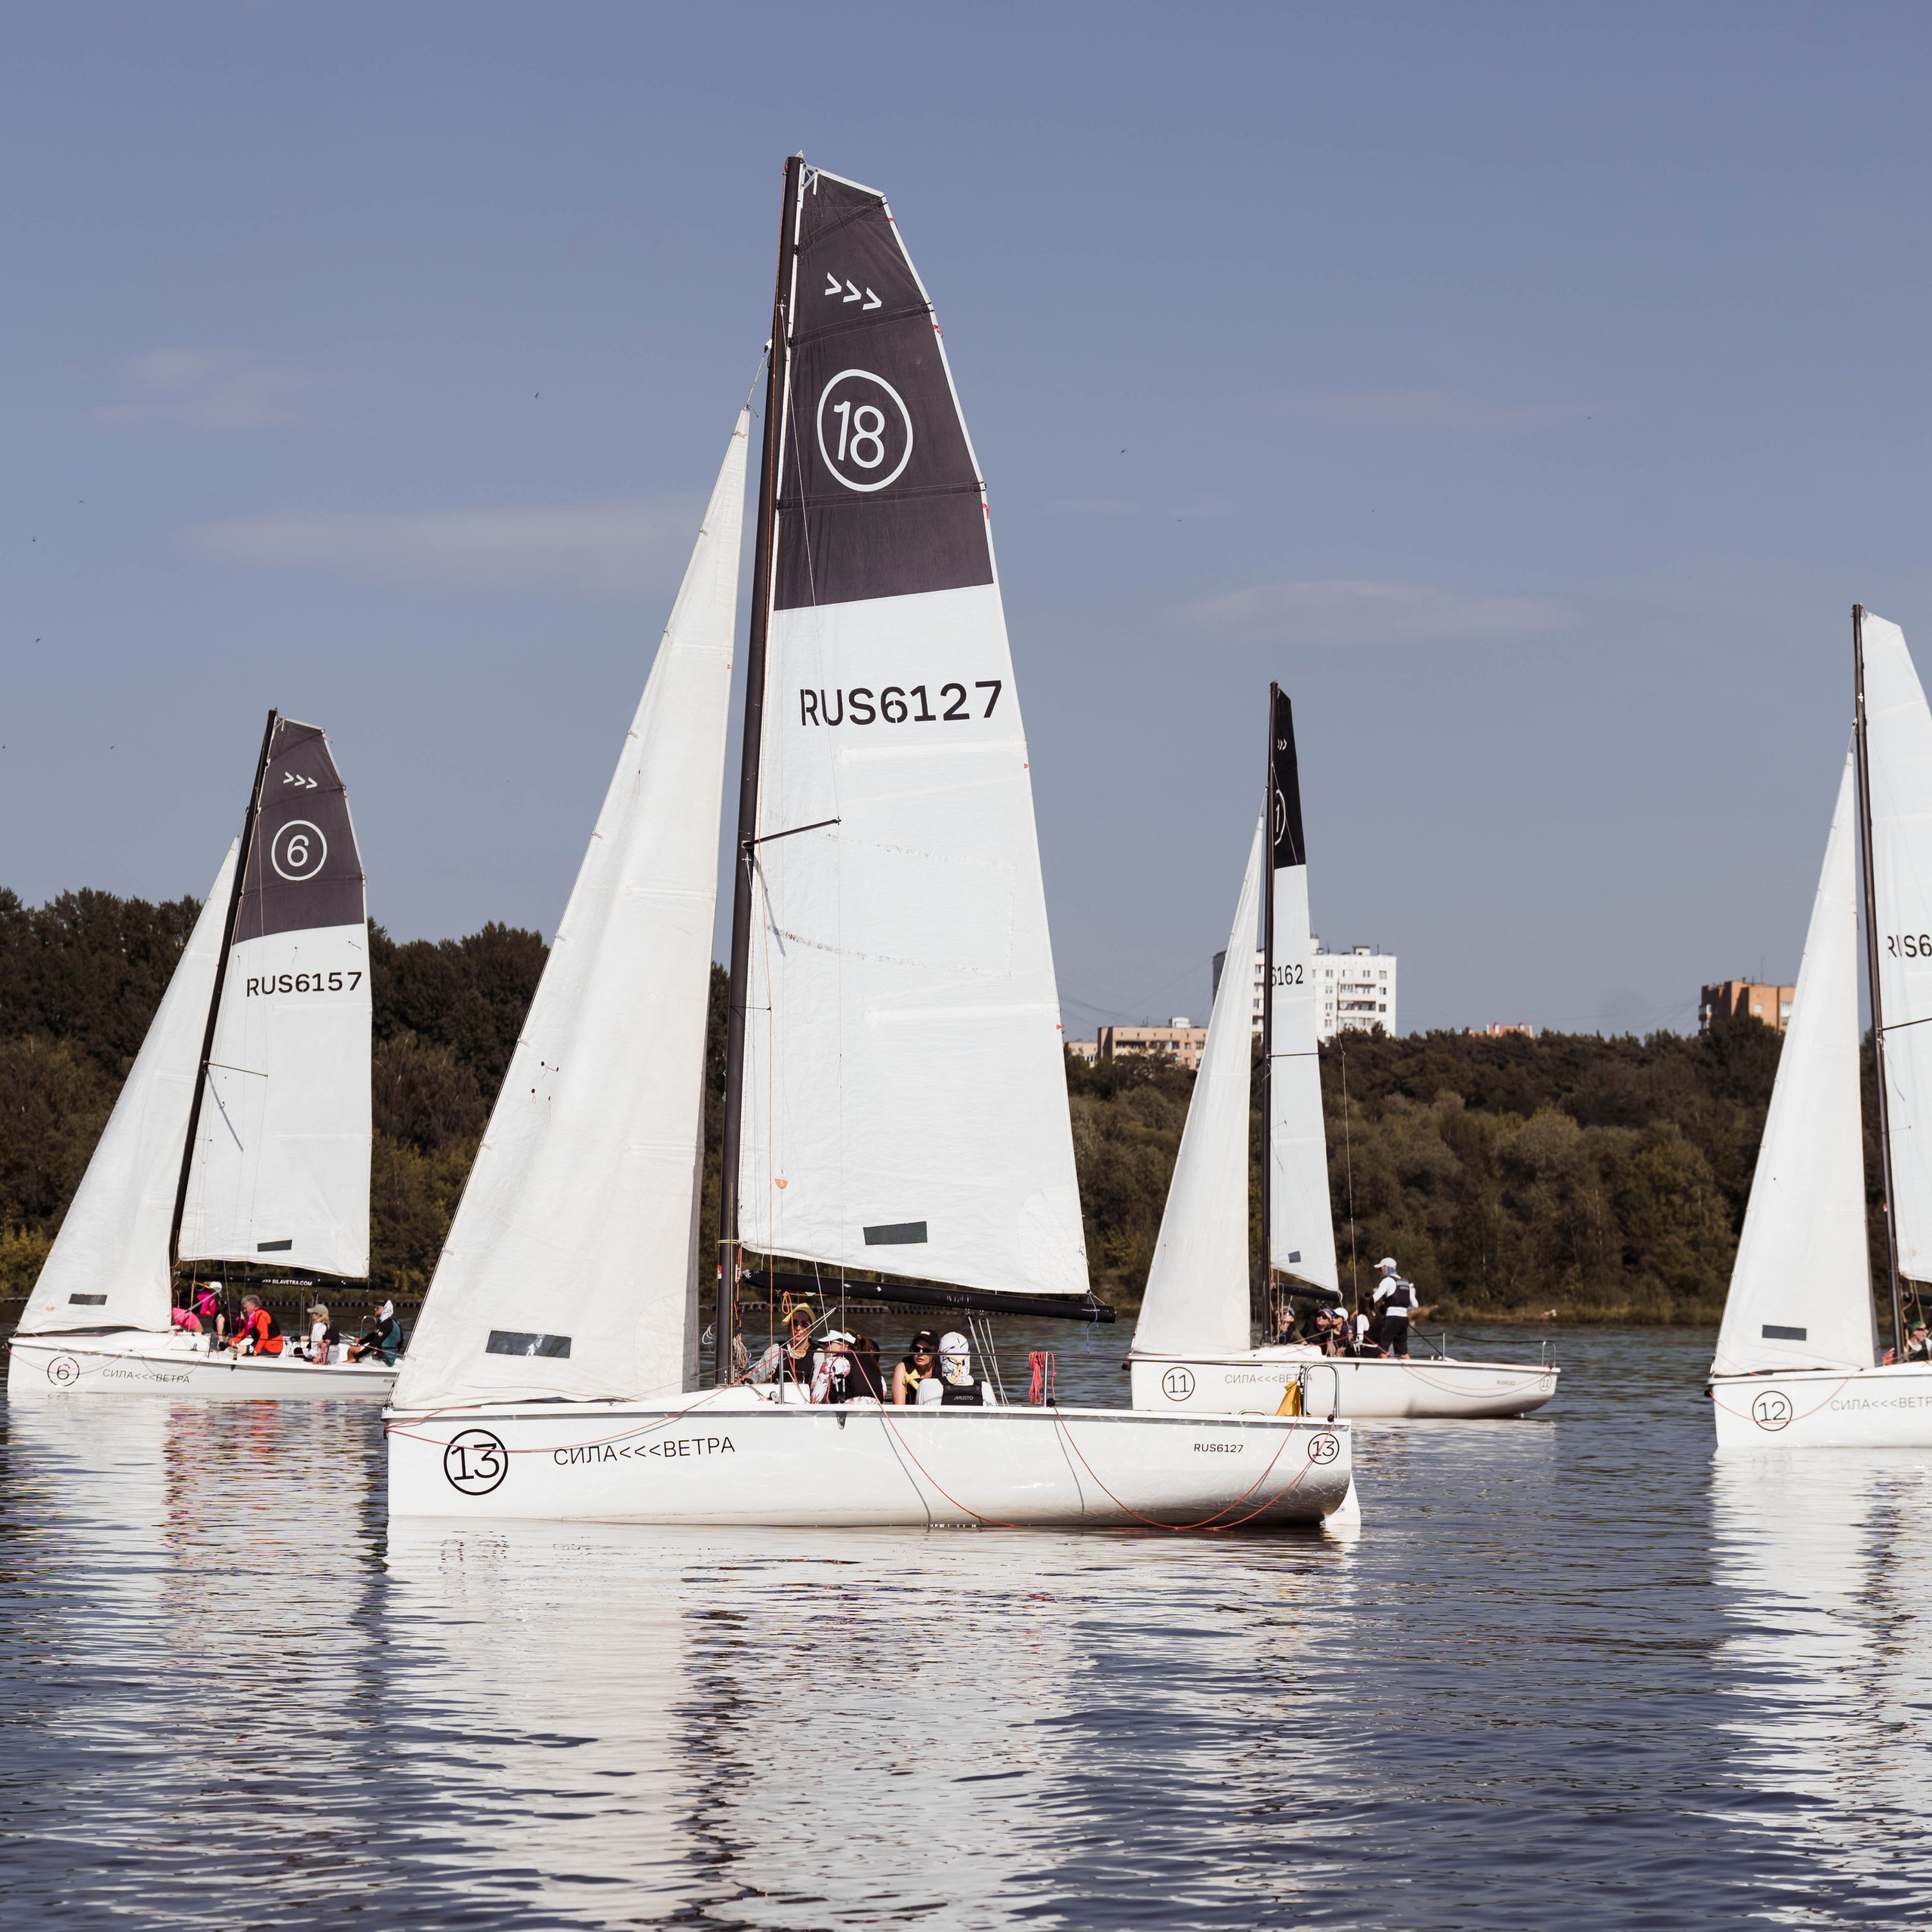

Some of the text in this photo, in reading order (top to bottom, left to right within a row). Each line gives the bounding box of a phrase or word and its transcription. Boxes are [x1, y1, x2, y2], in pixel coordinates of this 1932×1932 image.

[834, 401, 886, 469] 18
[801, 680, 1002, 727] RUS6127
[287, 835, 309, 867] 6
[246, 971, 362, 997] RUS6157
[57, 1364, 70, 1380] 6
[1168, 1374, 1190, 1393] 11
[1542, 1379, 1550, 1388] 11
[1758, 1401, 1787, 1422] 12
[1193, 1443, 1244, 1454] RUS6127
[1312, 1440, 1335, 1457] 13
[451, 1442, 500, 1481] 13
